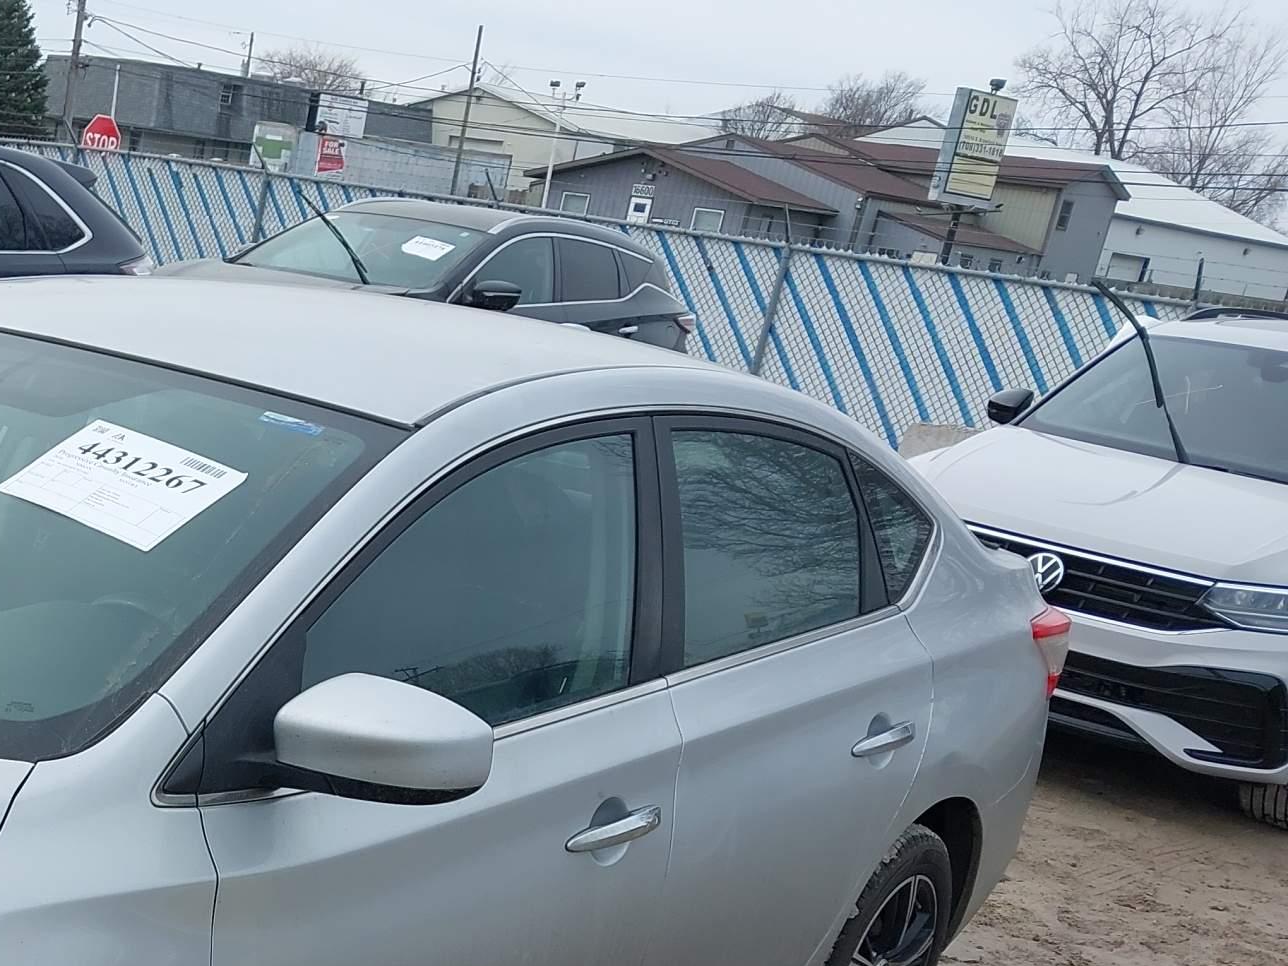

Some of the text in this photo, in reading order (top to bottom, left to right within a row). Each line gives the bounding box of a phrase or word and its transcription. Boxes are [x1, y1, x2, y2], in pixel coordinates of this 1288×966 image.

[968, 95, 998, 119] GDL
[85, 132, 118, 150] STOP
[324, 140, 339, 148] FOR
[322, 146, 340, 155] SALE
[78, 442, 208, 494] 44312267
